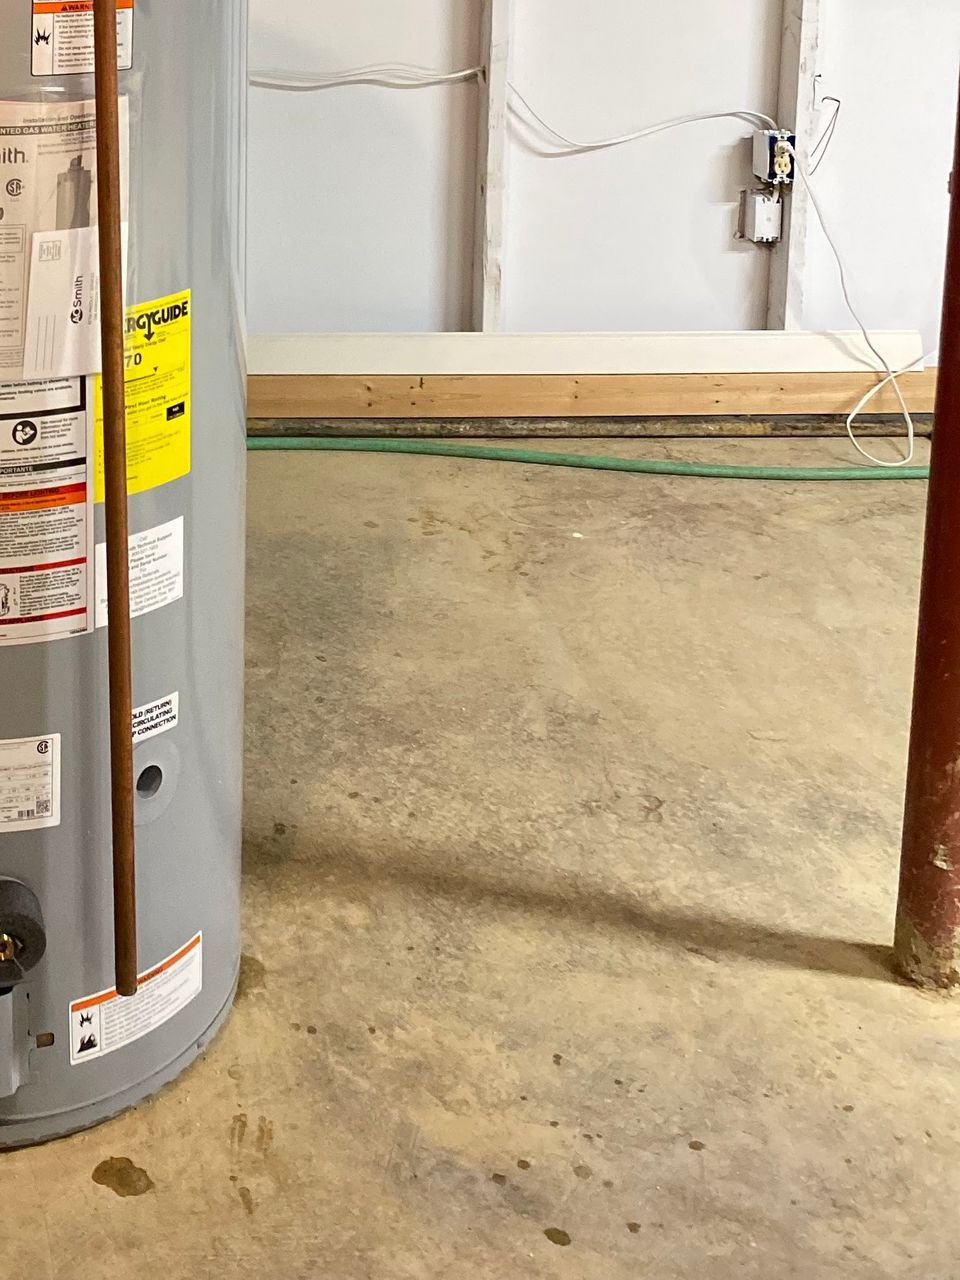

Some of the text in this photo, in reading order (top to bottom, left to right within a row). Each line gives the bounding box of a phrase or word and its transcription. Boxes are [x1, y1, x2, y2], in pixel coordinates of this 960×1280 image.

[23, 126, 39, 134] GAS
[41, 125, 68, 133] WATER
[73, 275, 83, 308] Smith
[125, 301, 188, 334] RGYGUIDE
[132, 699, 172, 720] OLD (RETURN)
[132, 708, 172, 728] CIRCULATING
[137, 714, 176, 735] CONNECTION
